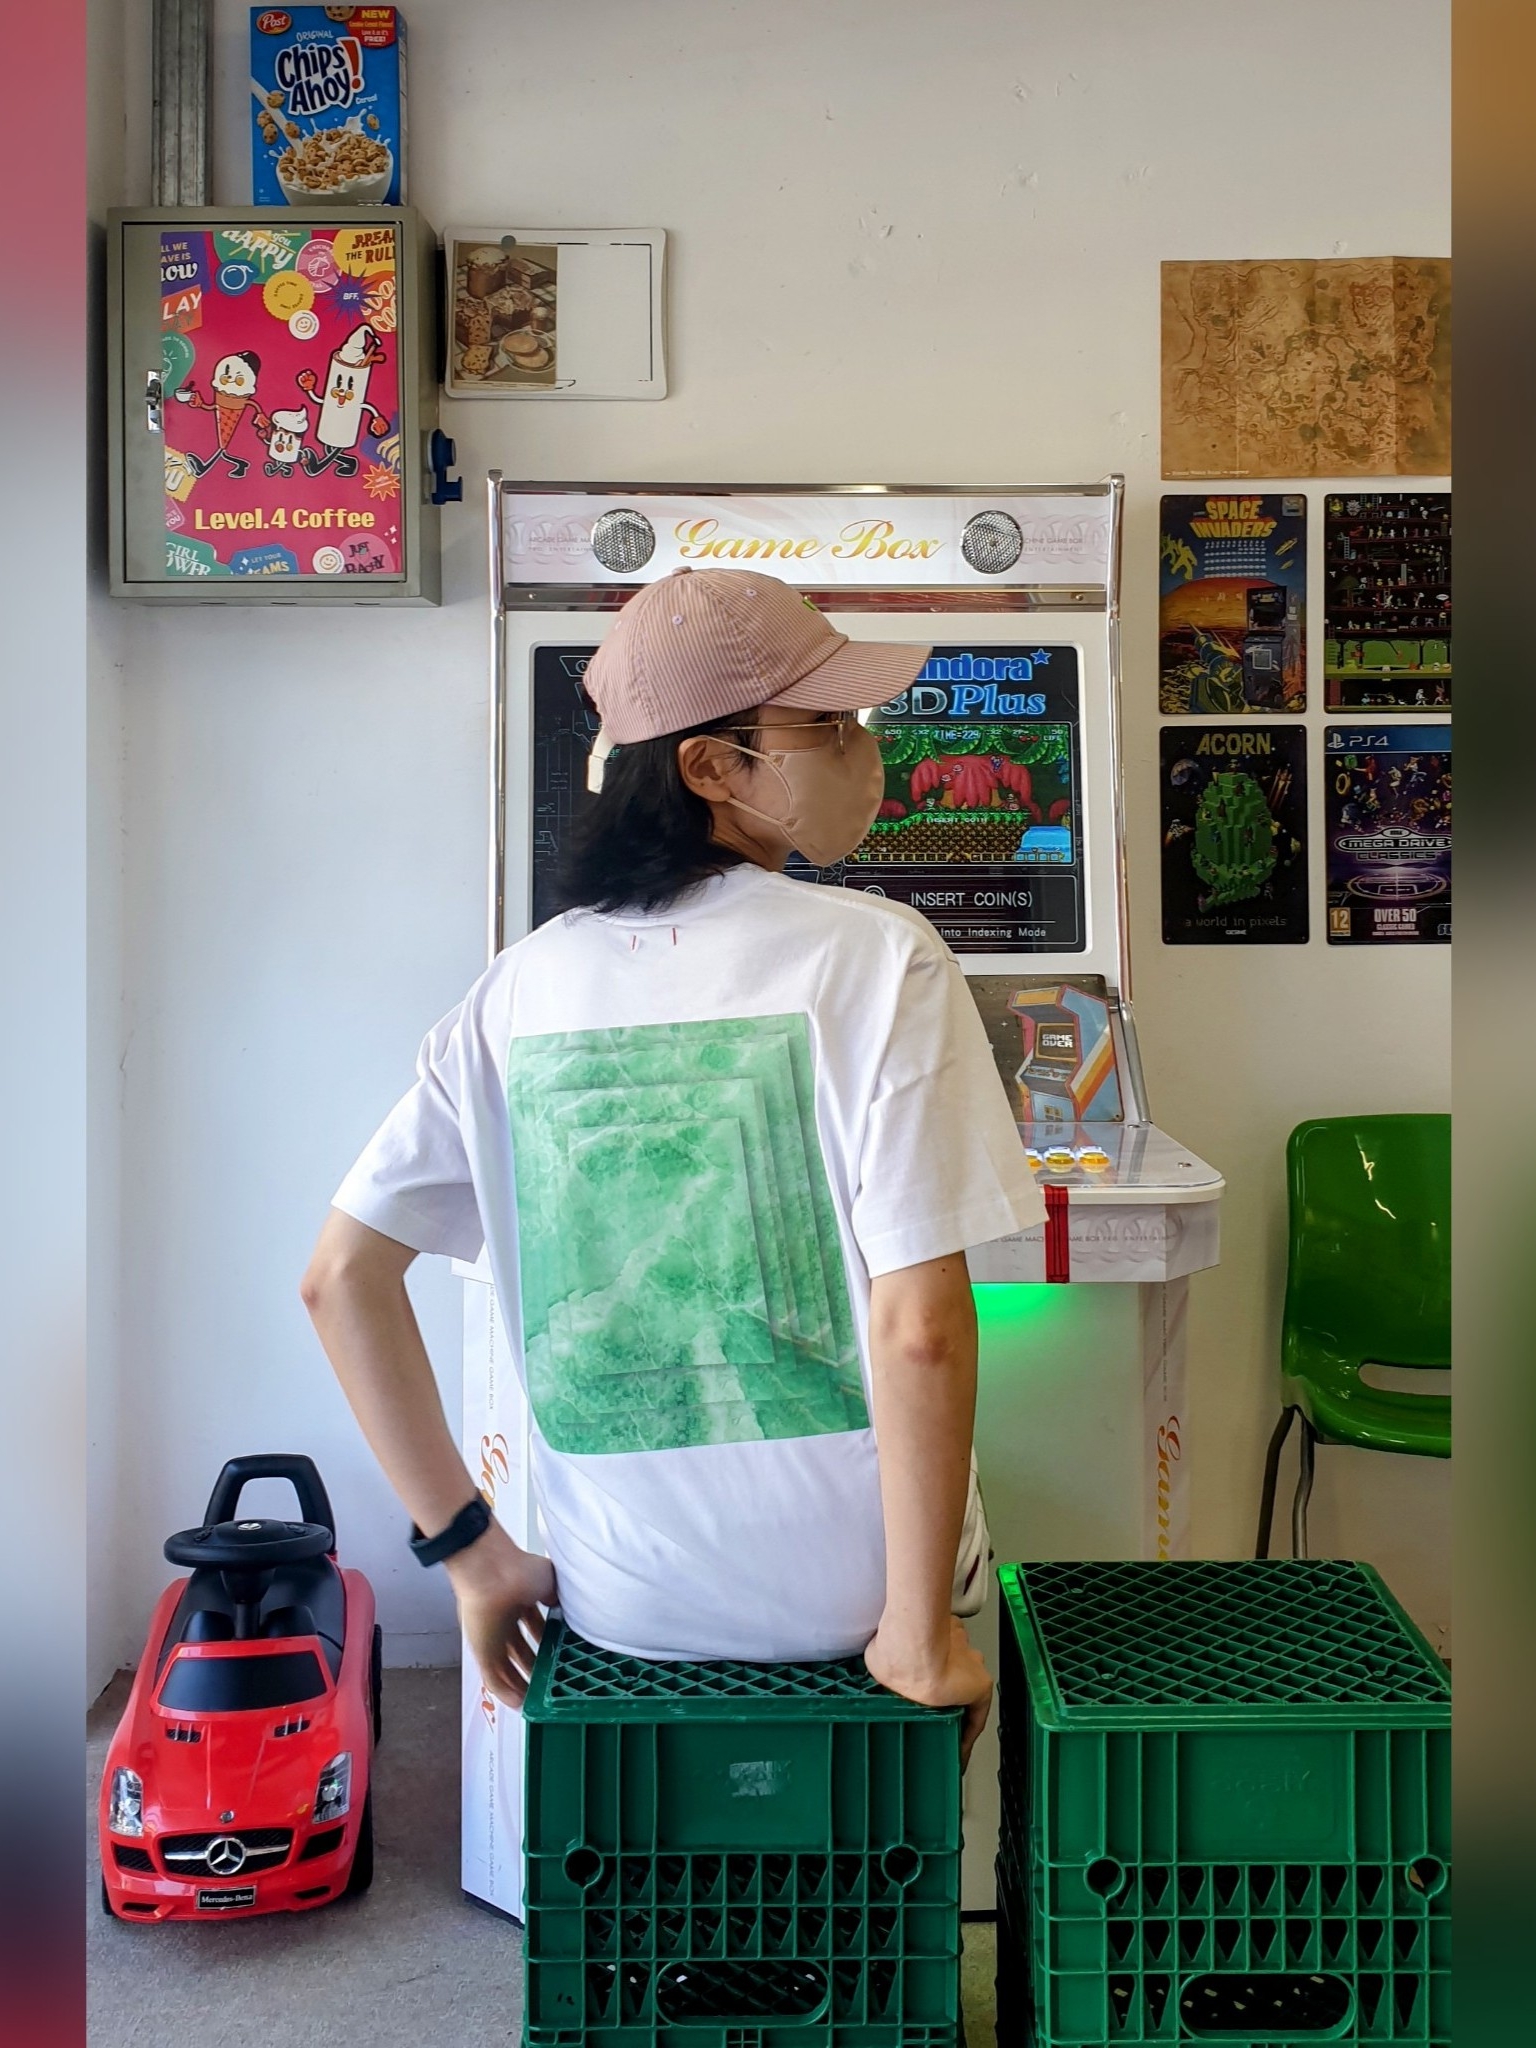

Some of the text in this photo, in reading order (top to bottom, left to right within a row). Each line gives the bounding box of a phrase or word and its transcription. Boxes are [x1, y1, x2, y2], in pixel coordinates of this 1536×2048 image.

[262, 13, 286, 29] Post
[361, 9, 391, 19] NEW
[296, 30, 334, 41] ORIGINAL
[276, 43, 347, 90] Chips
[172, 242, 188, 251] WE
[161, 252, 191, 263] AVE IS
[345, 250, 362, 261] THE
[343, 292, 360, 300] BFF.
[1205, 499, 1263, 520] SPACE
[194, 507, 288, 530] Level.4
[292, 507, 376, 529] Coffee
[1189, 520, 1278, 538] INVADERS
[674, 518, 947, 560] Game Box
[948, 684, 1047, 716] Plus
[1195, 732, 1271, 756] ACORN
[1349, 735, 1390, 747] PS4
[1348, 838, 1446, 848] MEGA DRIVE
[1356, 851, 1437, 860] CLASSICS
[911, 891, 1033, 908] INSERT COIN(S)
[1234, 916, 1246, 926] in
[1249, 915, 1287, 928] pixels
[1330, 910, 1349, 929] 12
[1374, 908, 1417, 923] OVER 50
[941, 927, 1046, 939] Into Indexing Mode
[1042, 1033, 1073, 1041] GAME
[1042, 1040, 1074, 1048] OVER
[1000, 1235, 1022, 1243] GAME
[1068, 1235, 1084, 1243] AME
[1085, 1235, 1100, 1243] BOX
[488, 1299, 496, 1324] GAME
[488, 1325, 496, 1364] MACHINE
[488, 1366, 496, 1391] GAME
[488, 1393, 496, 1410] BOX
[488, 1751, 496, 1897] ARCADE GAME MACHINE GAME BOX
